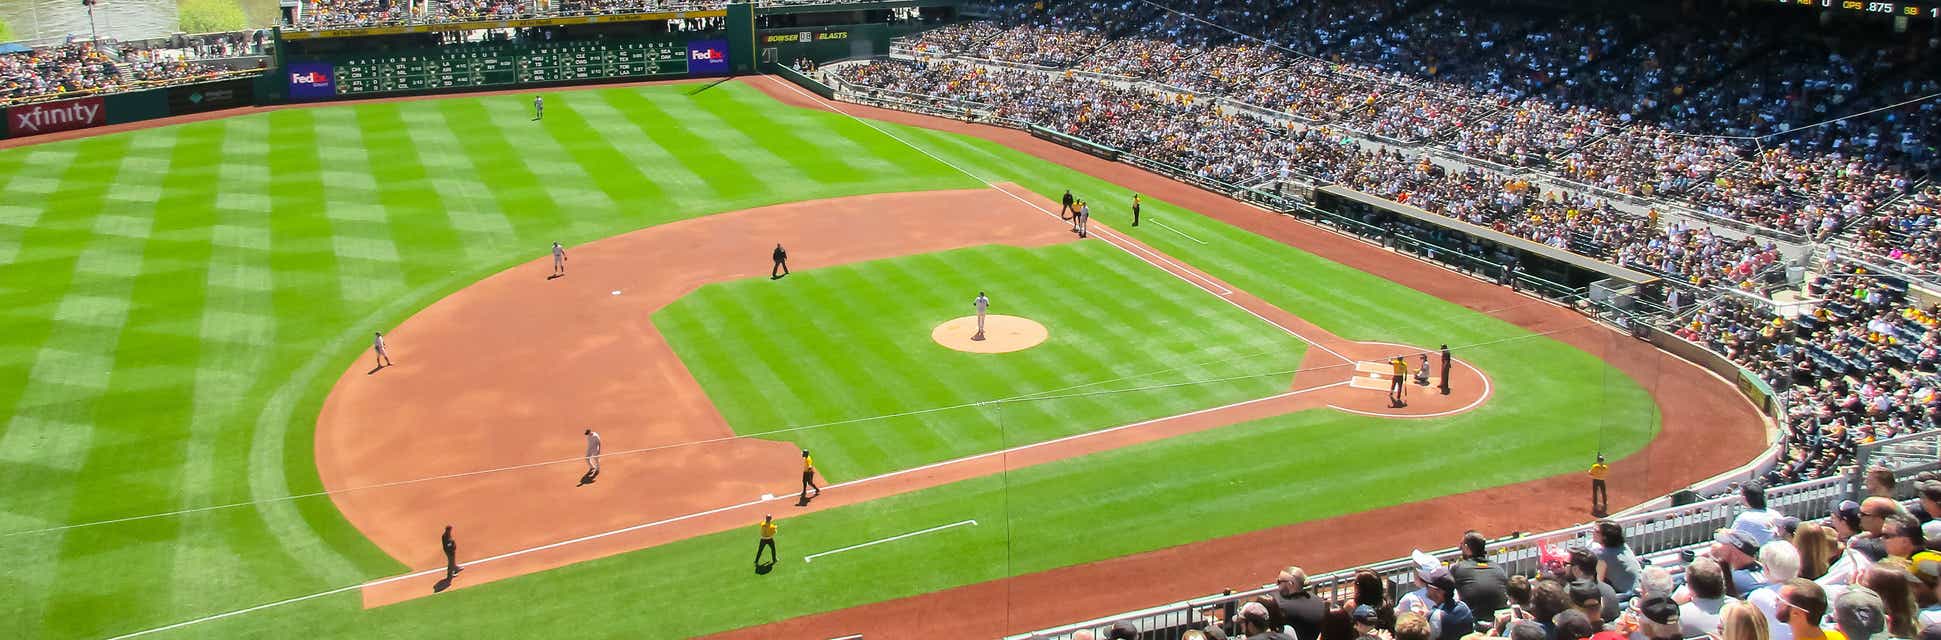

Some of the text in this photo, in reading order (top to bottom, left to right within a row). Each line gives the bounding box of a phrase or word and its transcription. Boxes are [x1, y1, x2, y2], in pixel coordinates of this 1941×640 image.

[1842, 1, 1863, 10] OPS
[1865, 2, 1893, 13] .875
[1930, 8, 1938, 18] 1
[767, 34, 799, 43] BOWSER
[819, 32, 848, 40] BLASTS
[531, 46, 607, 54] AMERICAN
[692, 49, 721, 60] FedEx
[349, 52, 497, 65] NATIONAL LEAGUE
[292, 72, 327, 84] FedEx
[16, 103, 100, 132] xfinity
